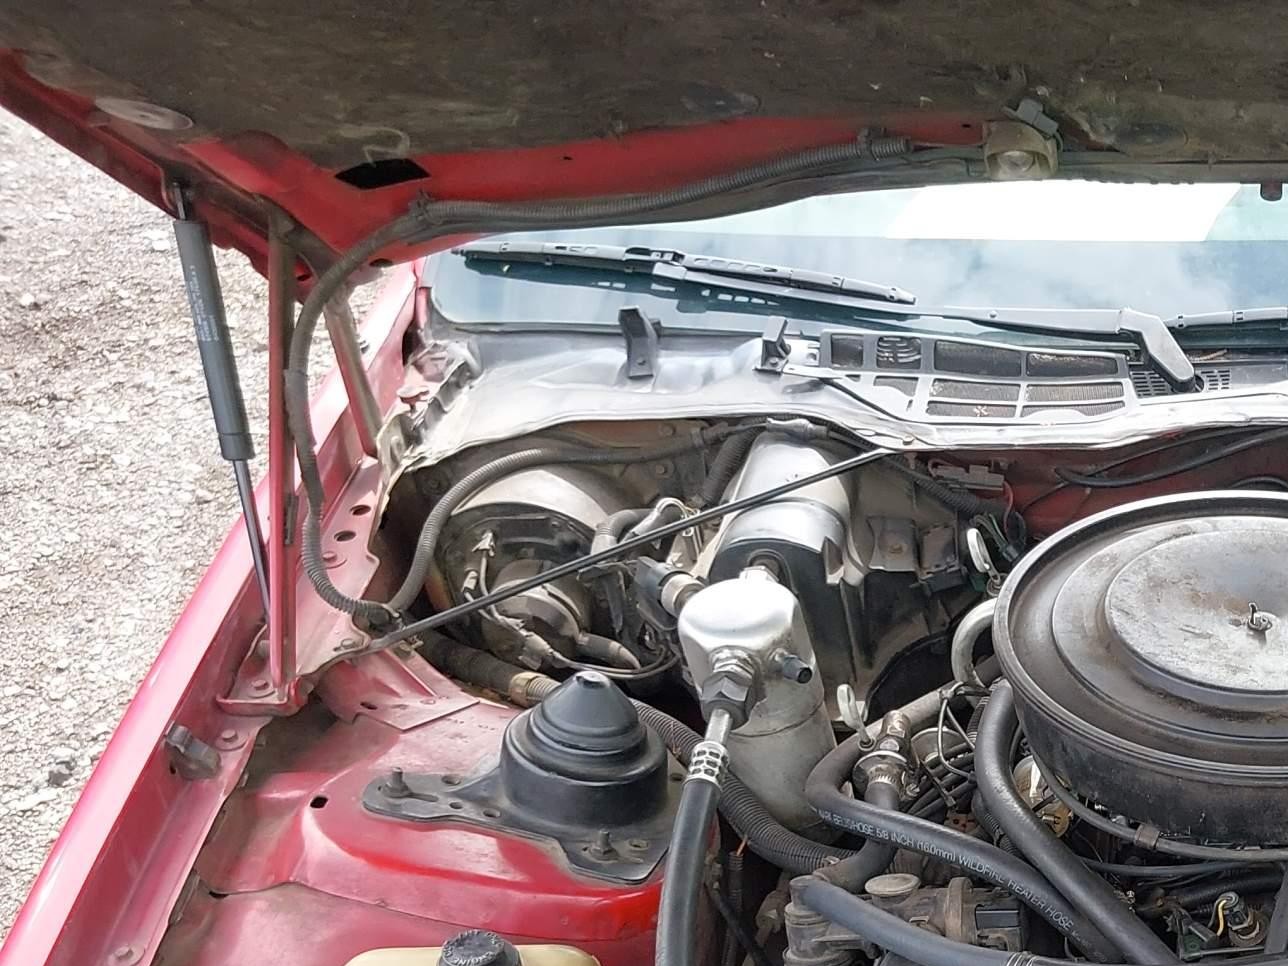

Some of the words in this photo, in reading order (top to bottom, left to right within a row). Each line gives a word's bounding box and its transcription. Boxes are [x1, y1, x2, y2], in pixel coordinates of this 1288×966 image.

[891, 832, 914, 847] INCH
[1007, 879, 1046, 910] HEATER
[1045, 905, 1075, 933] HOSE
